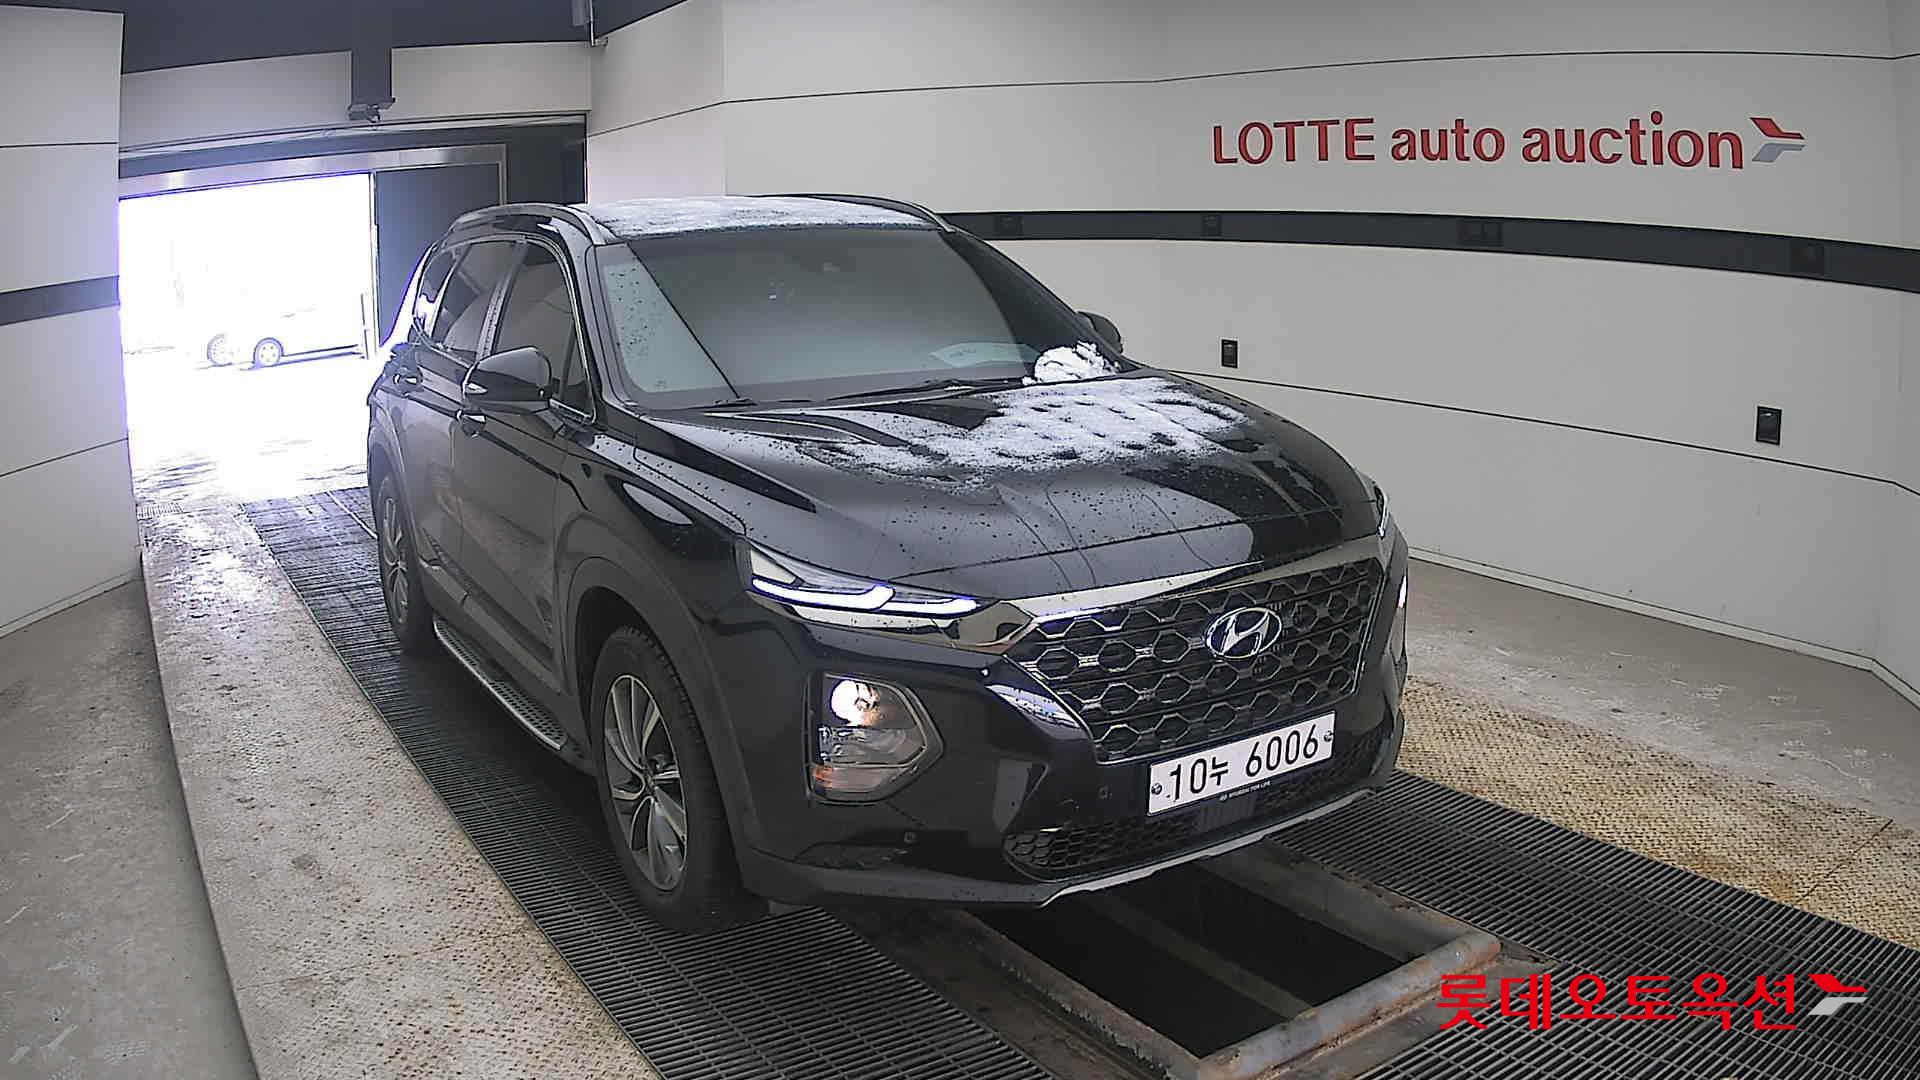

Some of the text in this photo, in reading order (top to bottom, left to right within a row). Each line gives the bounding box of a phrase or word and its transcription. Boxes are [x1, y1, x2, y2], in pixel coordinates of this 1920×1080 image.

[1213, 110, 1744, 169] LOTTE auto auction
[1169, 756, 1229, 801] 10누
[1245, 723, 1319, 777] 6006
